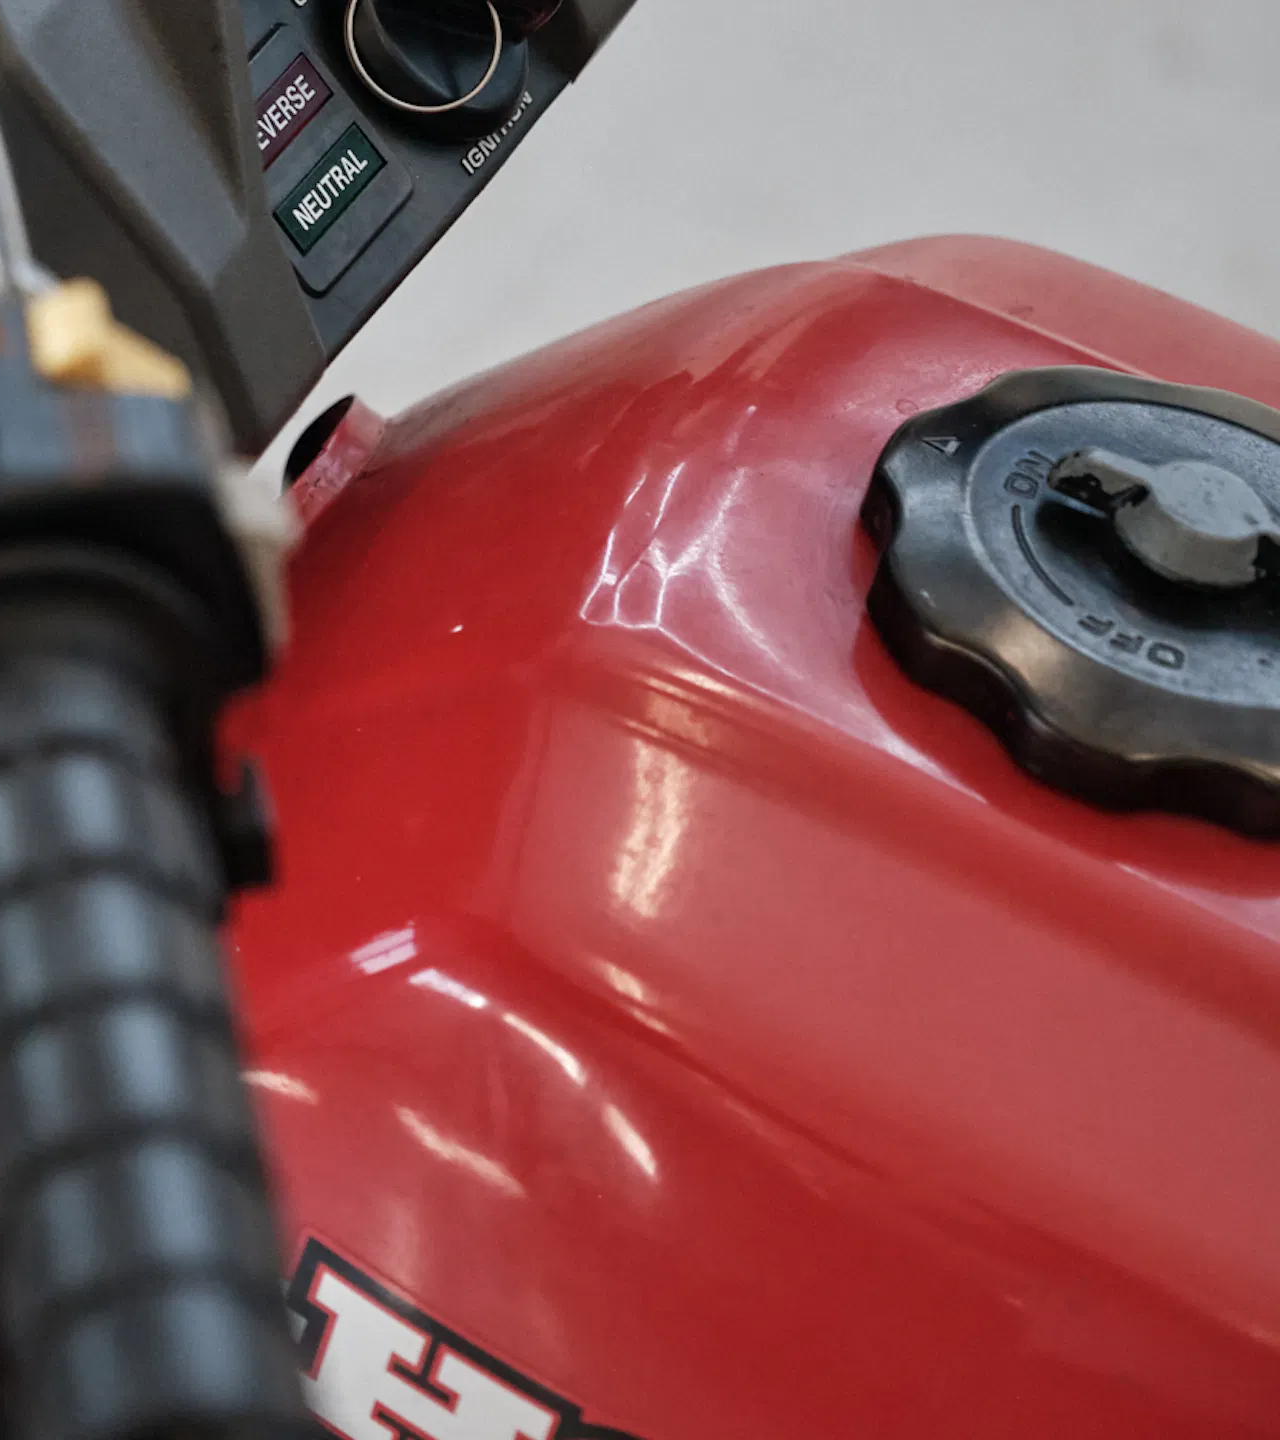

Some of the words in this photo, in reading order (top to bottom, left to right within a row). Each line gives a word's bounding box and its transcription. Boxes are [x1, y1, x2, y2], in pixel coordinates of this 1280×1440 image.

[292, 149, 368, 231] NEUTRAL
[1003, 450, 1056, 499] ON
[1077, 615, 1186, 671] OFF
